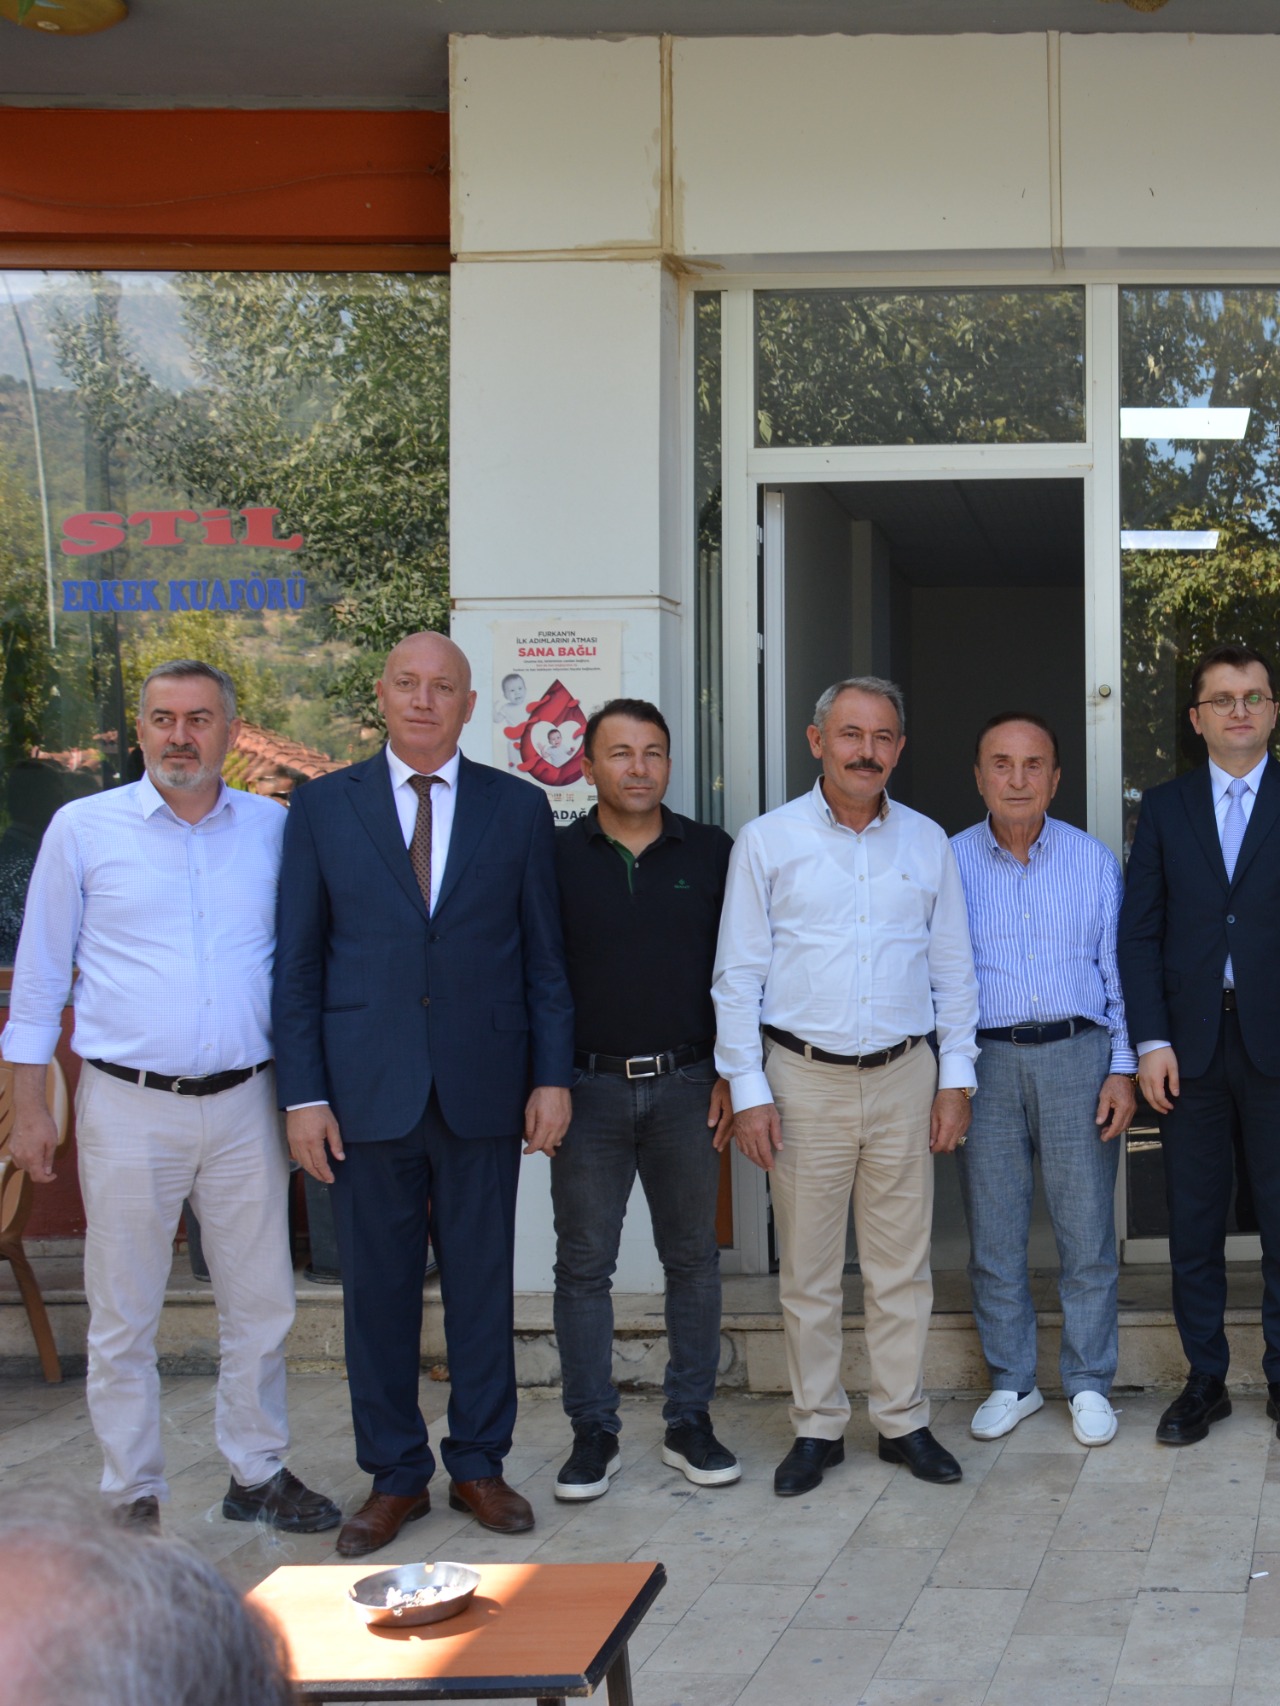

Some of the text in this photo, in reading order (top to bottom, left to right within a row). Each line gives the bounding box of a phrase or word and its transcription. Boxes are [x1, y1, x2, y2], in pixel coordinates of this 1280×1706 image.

[62, 571, 307, 612] ERKEK KUAFÖRÜ
[518, 644, 597, 657] SANA BAĞLI
[553, 808, 588, 820] ADAĞ
